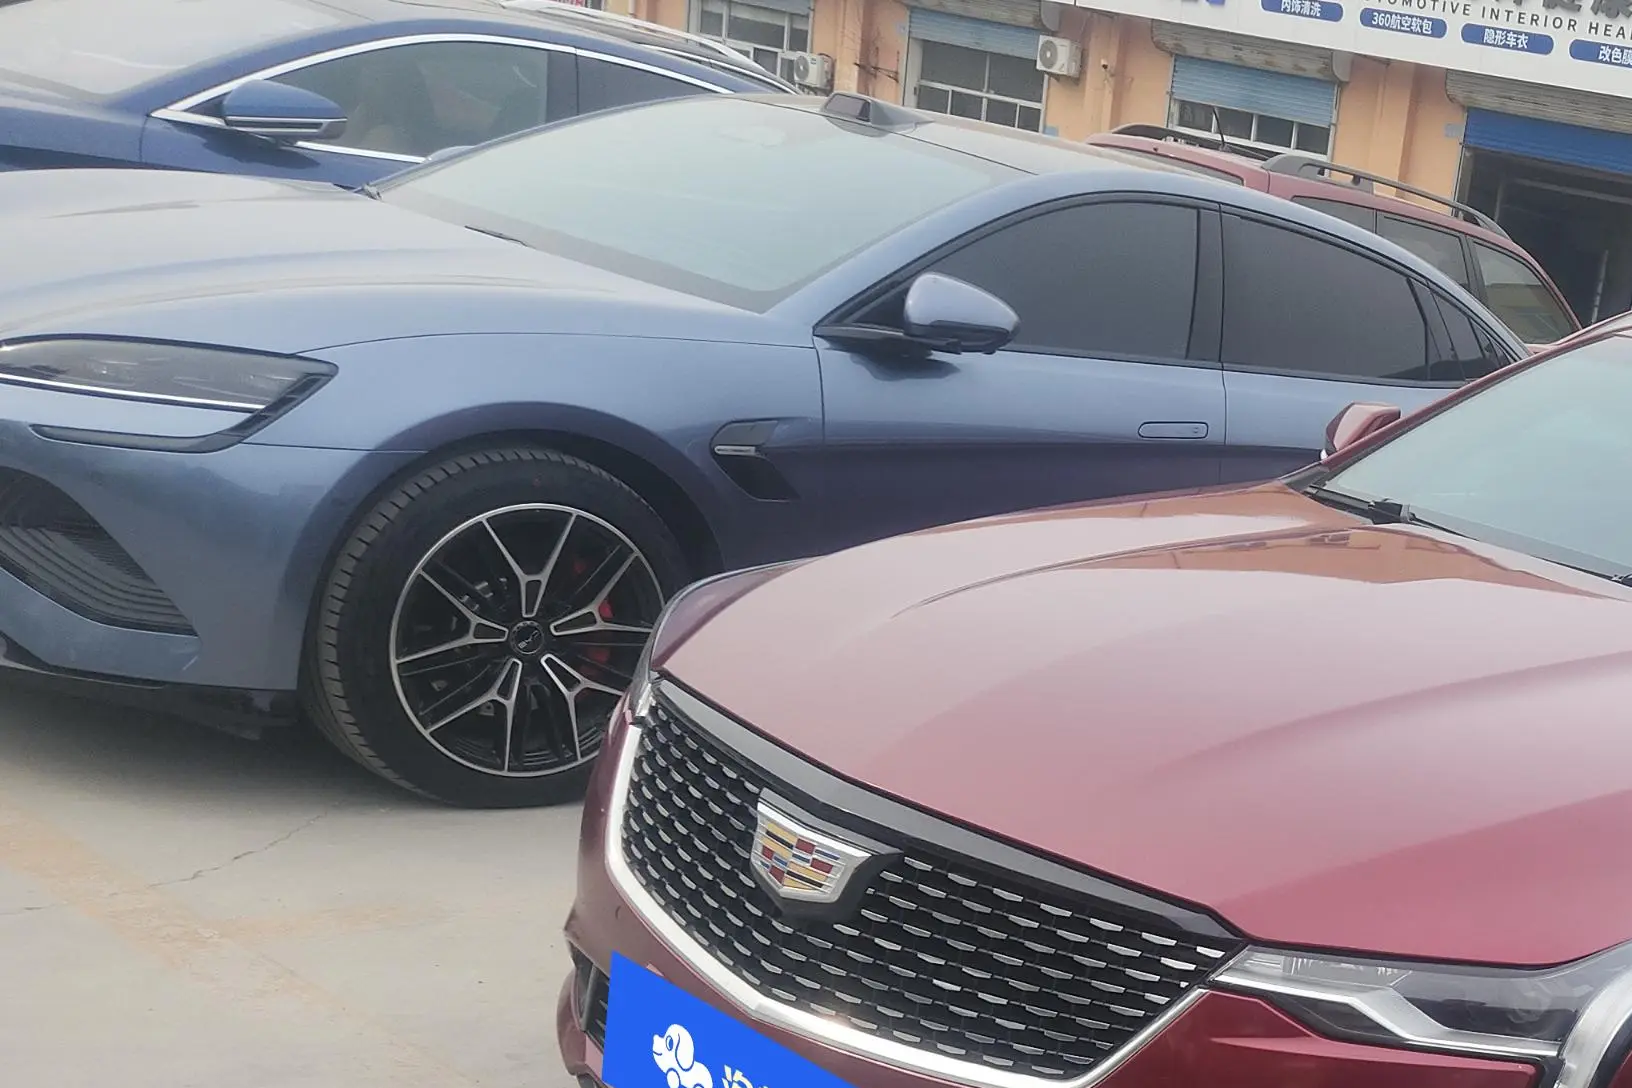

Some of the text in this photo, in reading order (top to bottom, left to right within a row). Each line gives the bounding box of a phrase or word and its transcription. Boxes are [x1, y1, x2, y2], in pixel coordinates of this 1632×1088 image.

[1371, 12, 1433, 35] 360航空软包
[1483, 28, 1529, 49] 隐形车衣
[1481, 6, 1578, 32] INTERIOR
